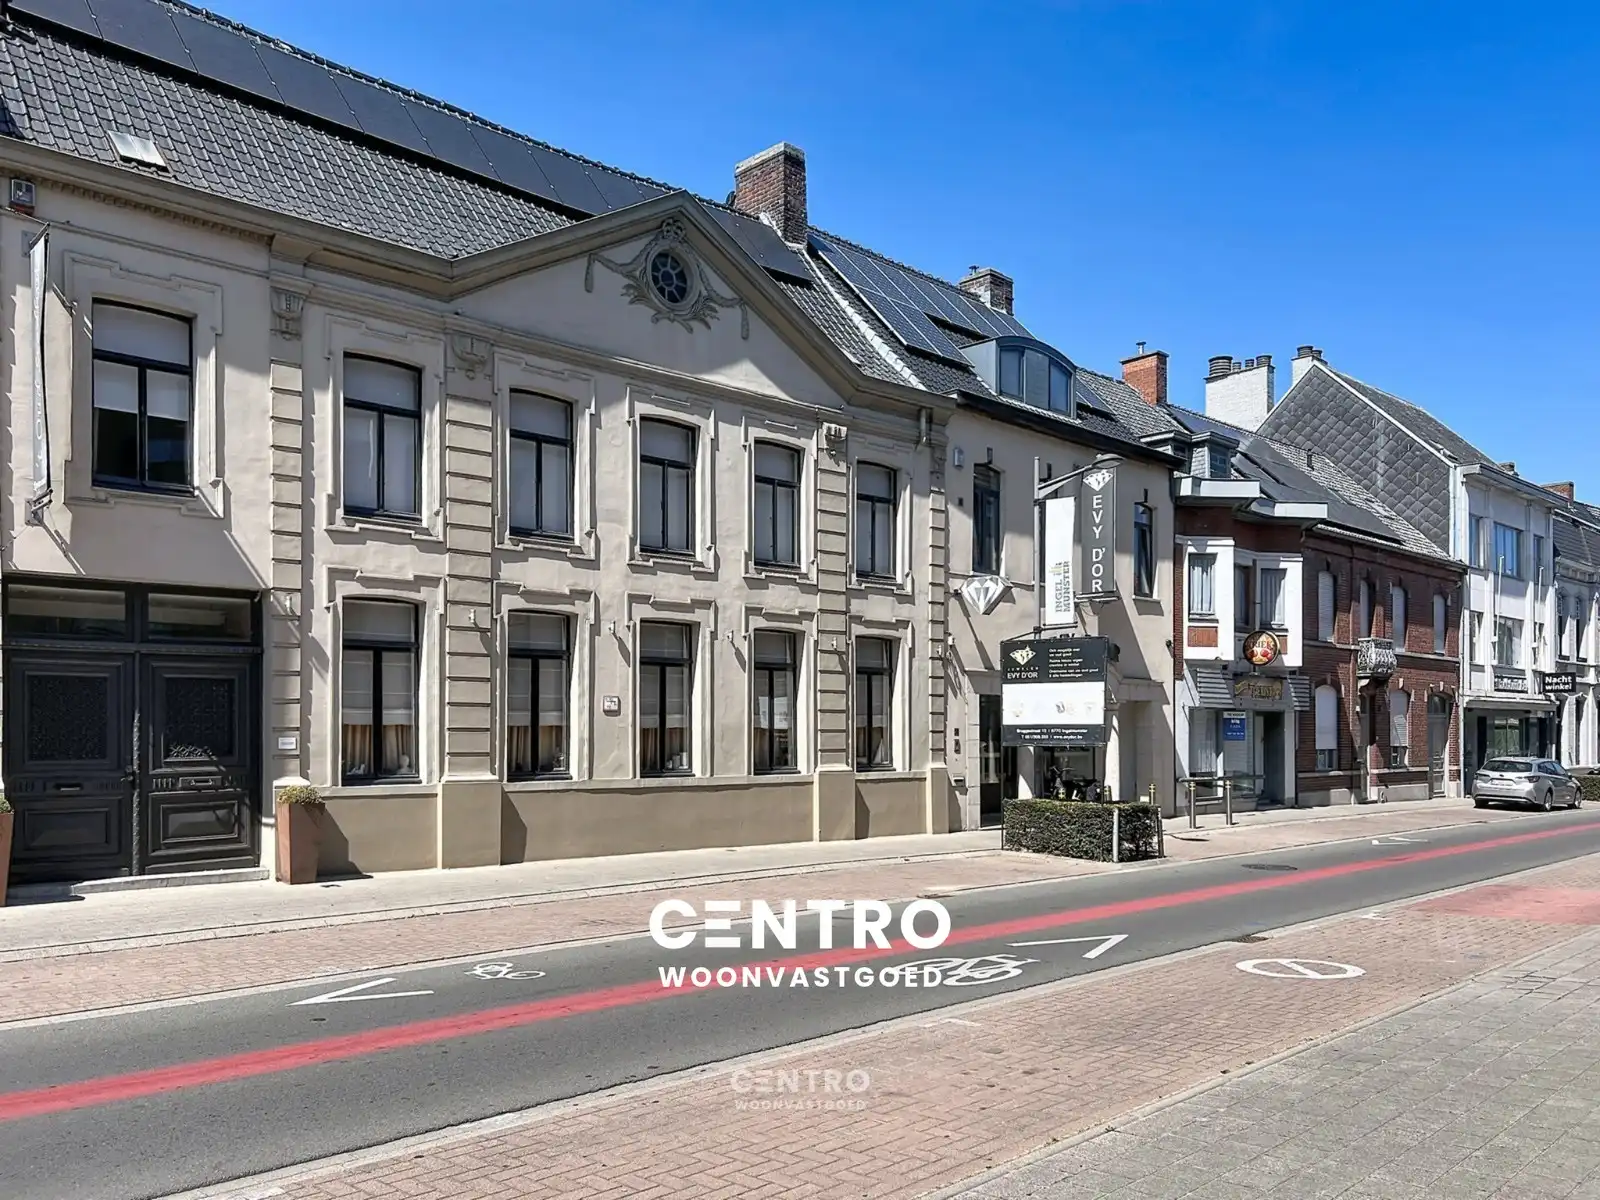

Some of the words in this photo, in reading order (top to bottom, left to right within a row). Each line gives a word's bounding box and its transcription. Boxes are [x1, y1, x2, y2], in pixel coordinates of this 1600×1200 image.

[1092, 495, 1103, 539] EVY
[1092, 547, 1105, 593] D'OR
[1055, 579, 1063, 612] INGEL
[1545, 675, 1572, 683] Nacht
